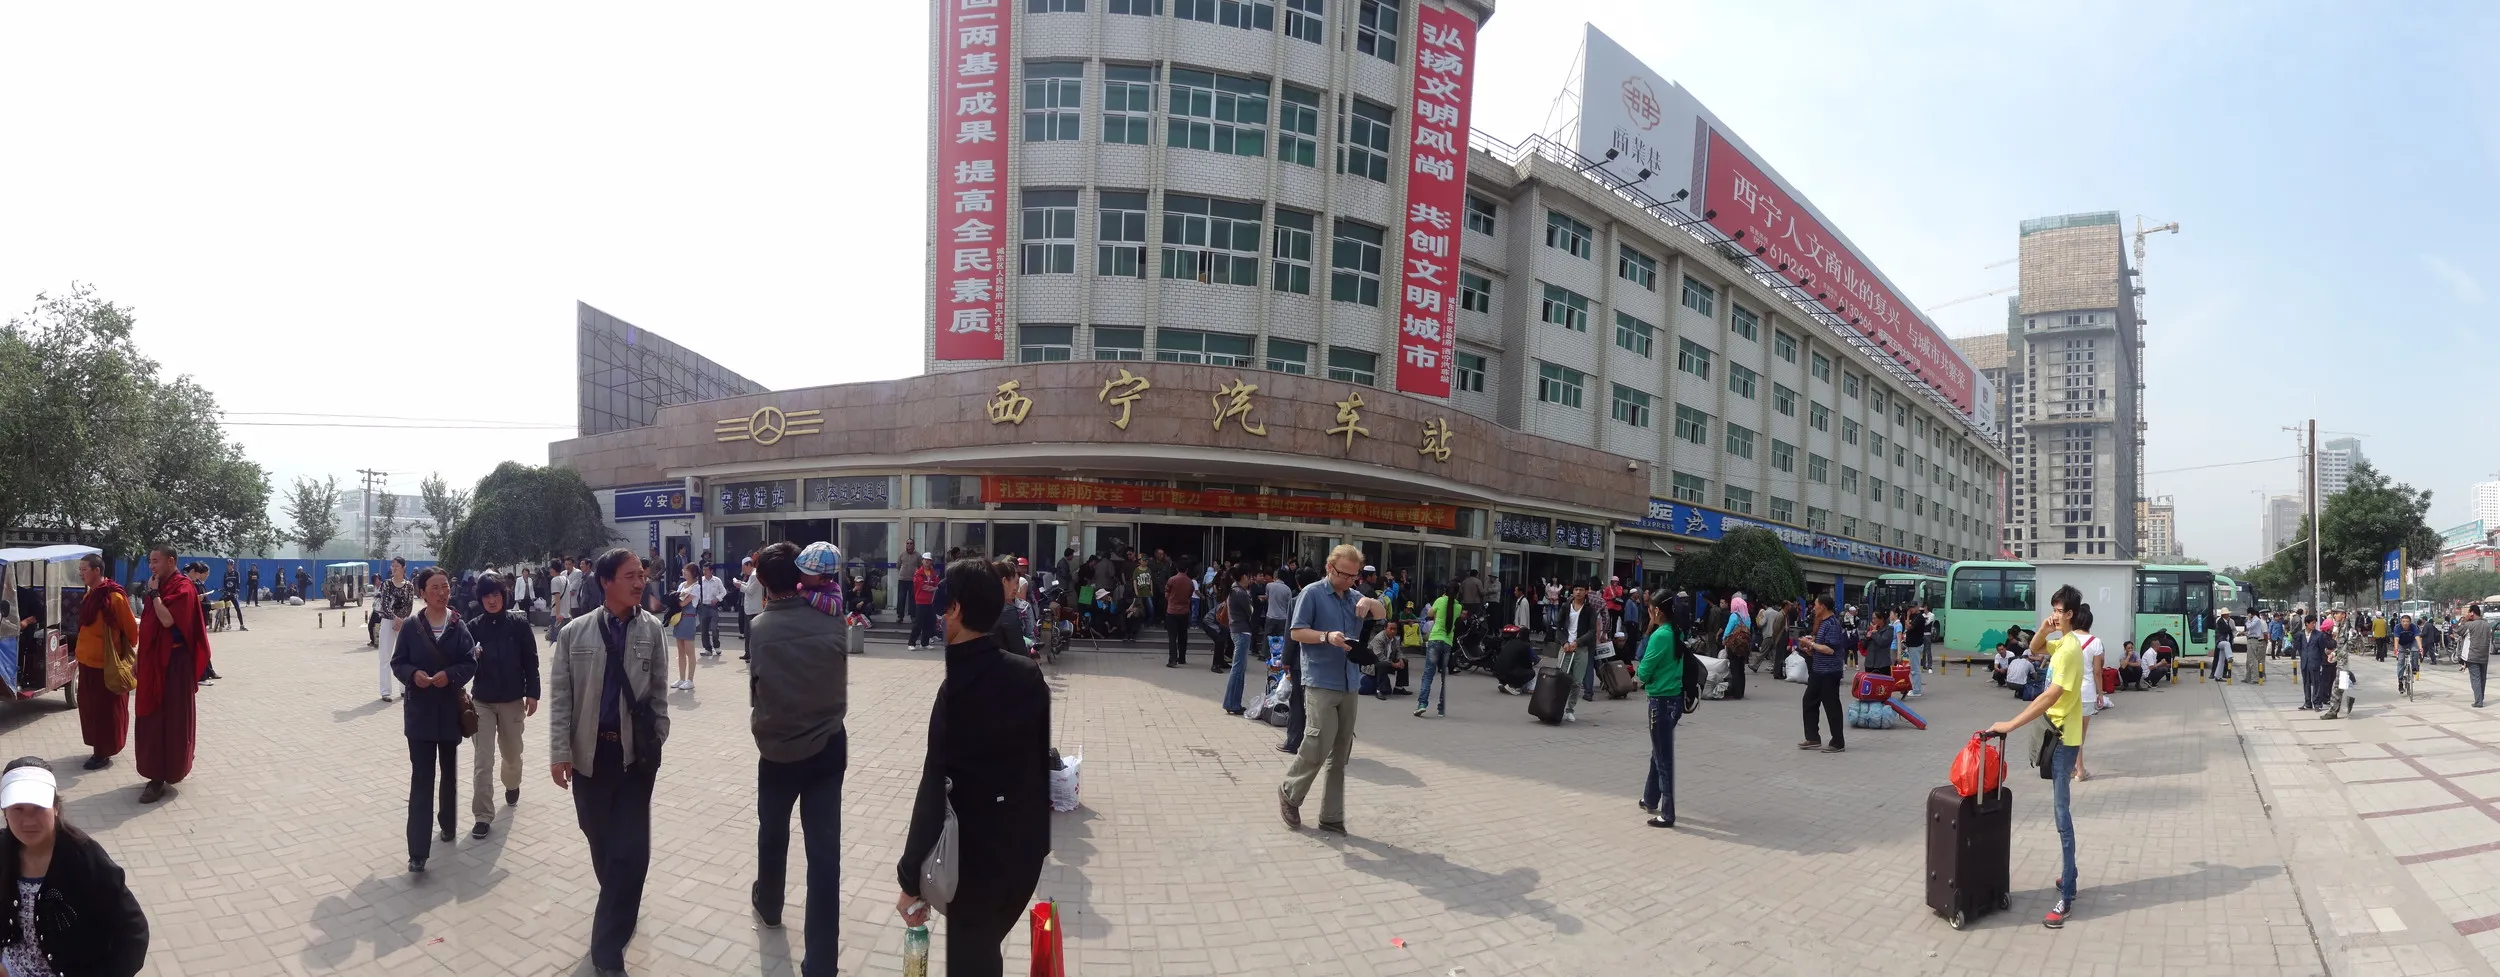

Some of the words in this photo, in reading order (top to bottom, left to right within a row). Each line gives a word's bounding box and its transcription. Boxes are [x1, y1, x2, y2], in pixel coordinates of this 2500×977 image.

[1414, 22, 1465, 182] 弘扬文明风尚
[949, 160, 996, 334] 提高全民素质
[1770, 244, 1817, 289] 6102622
[1402, 202, 1452, 369] 共创文明城市
[1733, 169, 1901, 333] 西宁人文商业的复兴
[1907, 322, 1966, 389] 与城市共繁荣
[994, 302, 1004, 341] 西宁汽车站
[1838, 296, 1874, 332] 6139666
[987, 369, 1453, 464] 西宁汽车站
[643, 494, 668, 508] 公安
[721, 486, 785, 511] 安检进站
[1000, 481, 1124, 502] 扎实开展消防安全
[1556, 525, 1602, 548] 安检进站
[1642, 521, 1675, 531] EXPRESS
